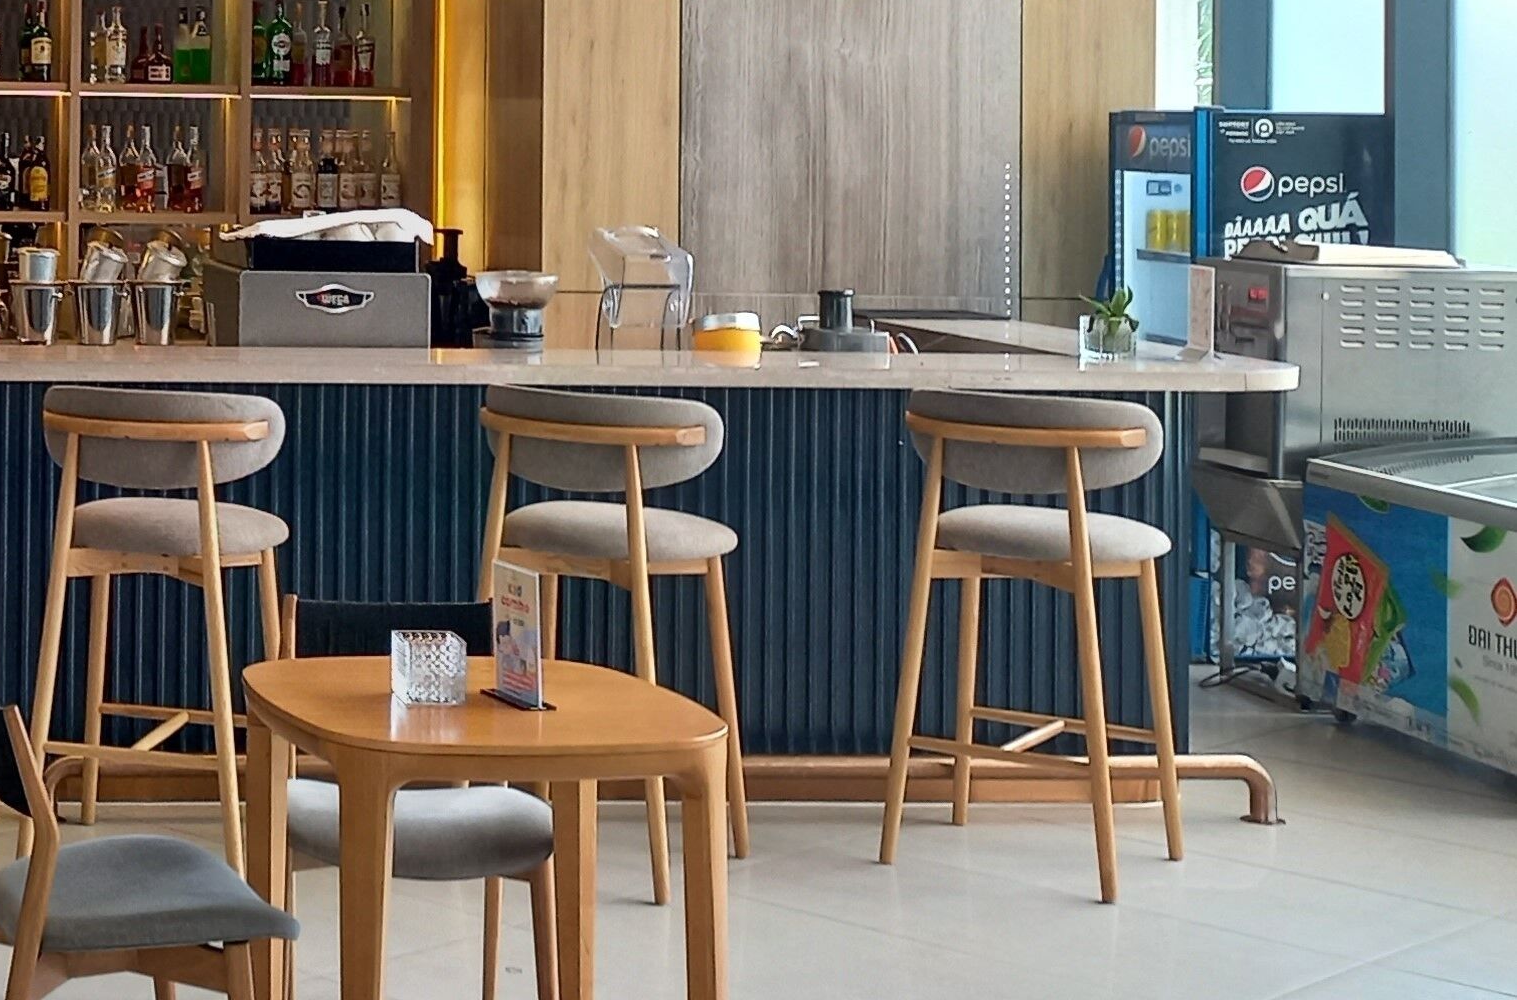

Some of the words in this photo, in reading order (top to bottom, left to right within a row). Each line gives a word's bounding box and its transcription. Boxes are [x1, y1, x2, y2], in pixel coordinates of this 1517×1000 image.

[1149, 133, 1191, 161] pepsi
[1278, 172, 1344, 198] pepsi
[1298, 192, 1369, 232] QUÁ
[1268, 574, 1296, 595] pe
